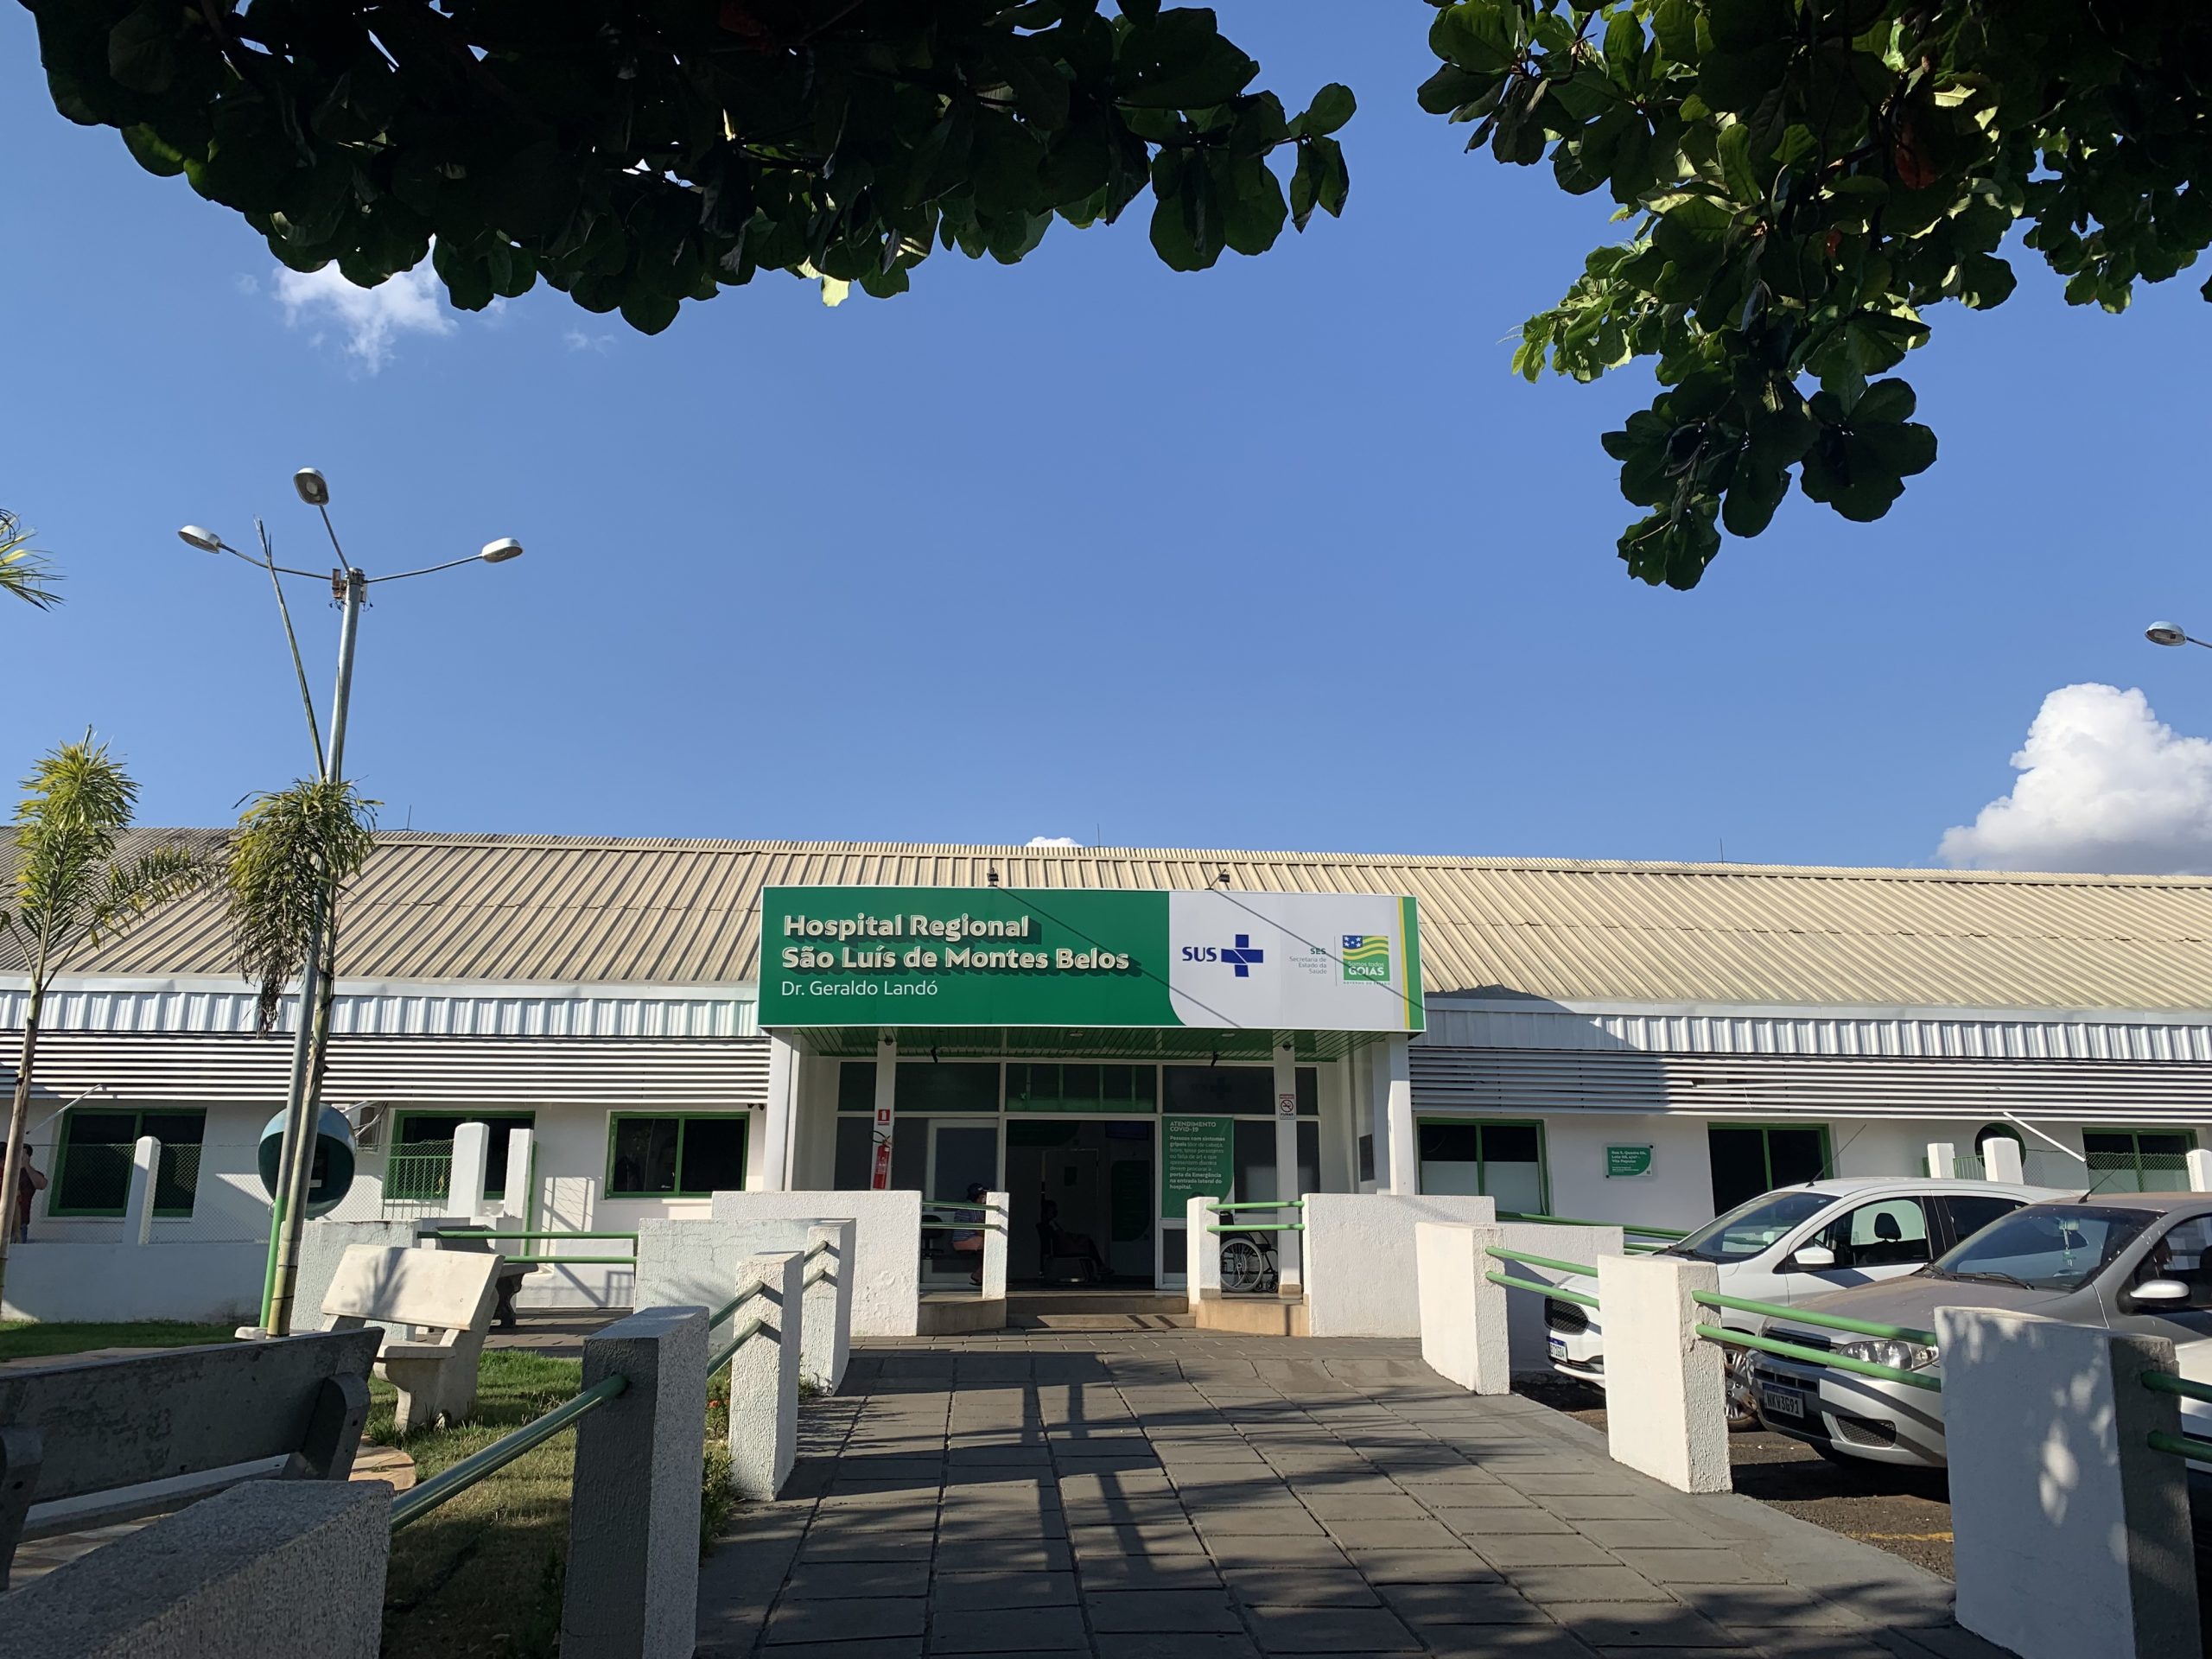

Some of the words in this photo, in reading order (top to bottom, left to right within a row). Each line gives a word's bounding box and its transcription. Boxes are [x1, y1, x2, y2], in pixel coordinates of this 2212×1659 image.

[784, 912, 902, 941] Hospital
[910, 914, 1028, 942] Regional
[782, 947, 834, 969] São
[842, 946, 896, 969] Luís
[904, 947, 938, 968] de
[945, 947, 1048, 969] Montes
[1056, 949, 1129, 969] Belos
[1182, 947, 1217, 962] SUS
[781, 982, 805, 996] Dr.
[810, 981, 878, 997] Geraldo
[884, 980, 938, 996] Landó
[1767, 1392, 1799, 1414] NKV3G91
